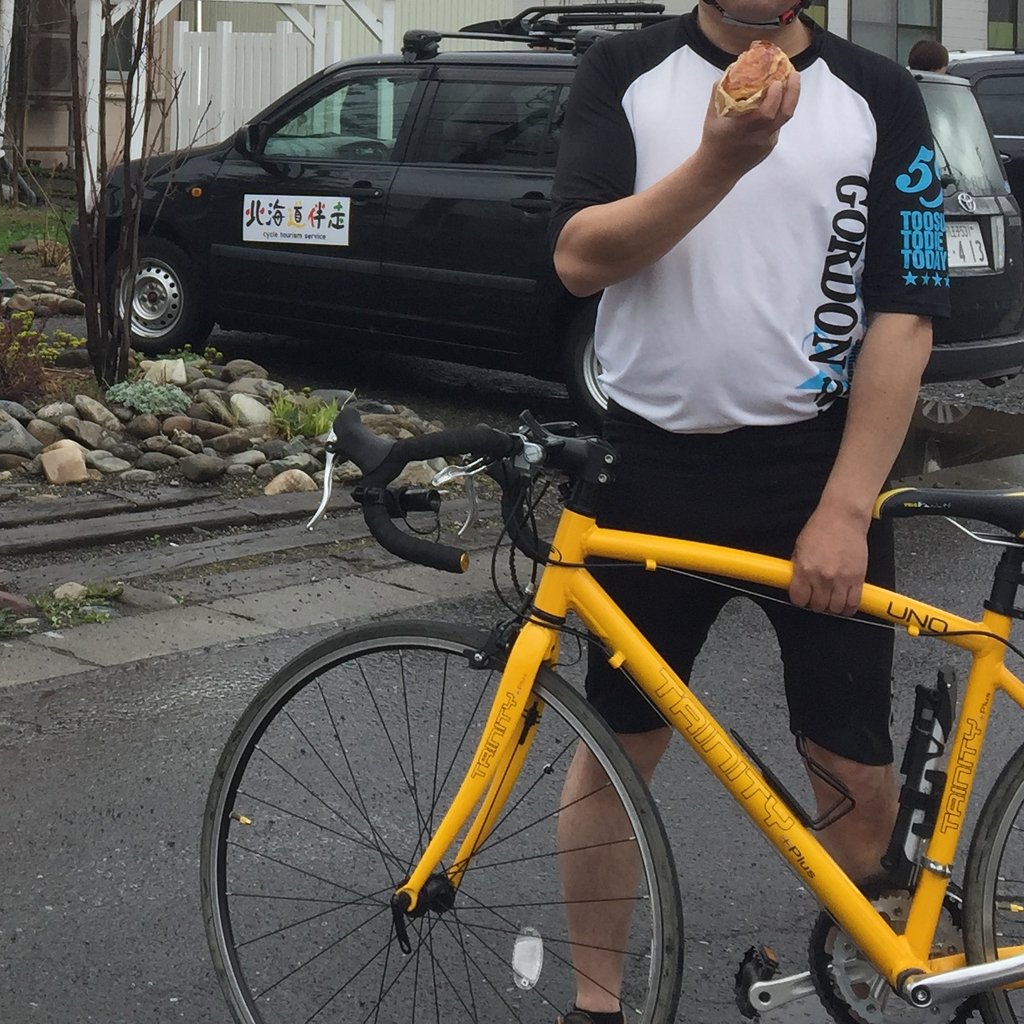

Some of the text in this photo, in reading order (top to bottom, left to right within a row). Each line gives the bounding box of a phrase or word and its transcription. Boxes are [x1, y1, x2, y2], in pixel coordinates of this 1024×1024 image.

[245, 199, 345, 230] 北海道伴走
[263, 231, 327, 240] cycle tourism service
[901, 249, 948, 271] TODAY
[886, 601, 949, 633] UNO
[470, 691, 517, 780] TRINITY
[655, 666, 796, 832] TRINITY
[939, 717, 983, 835] TRINITY
